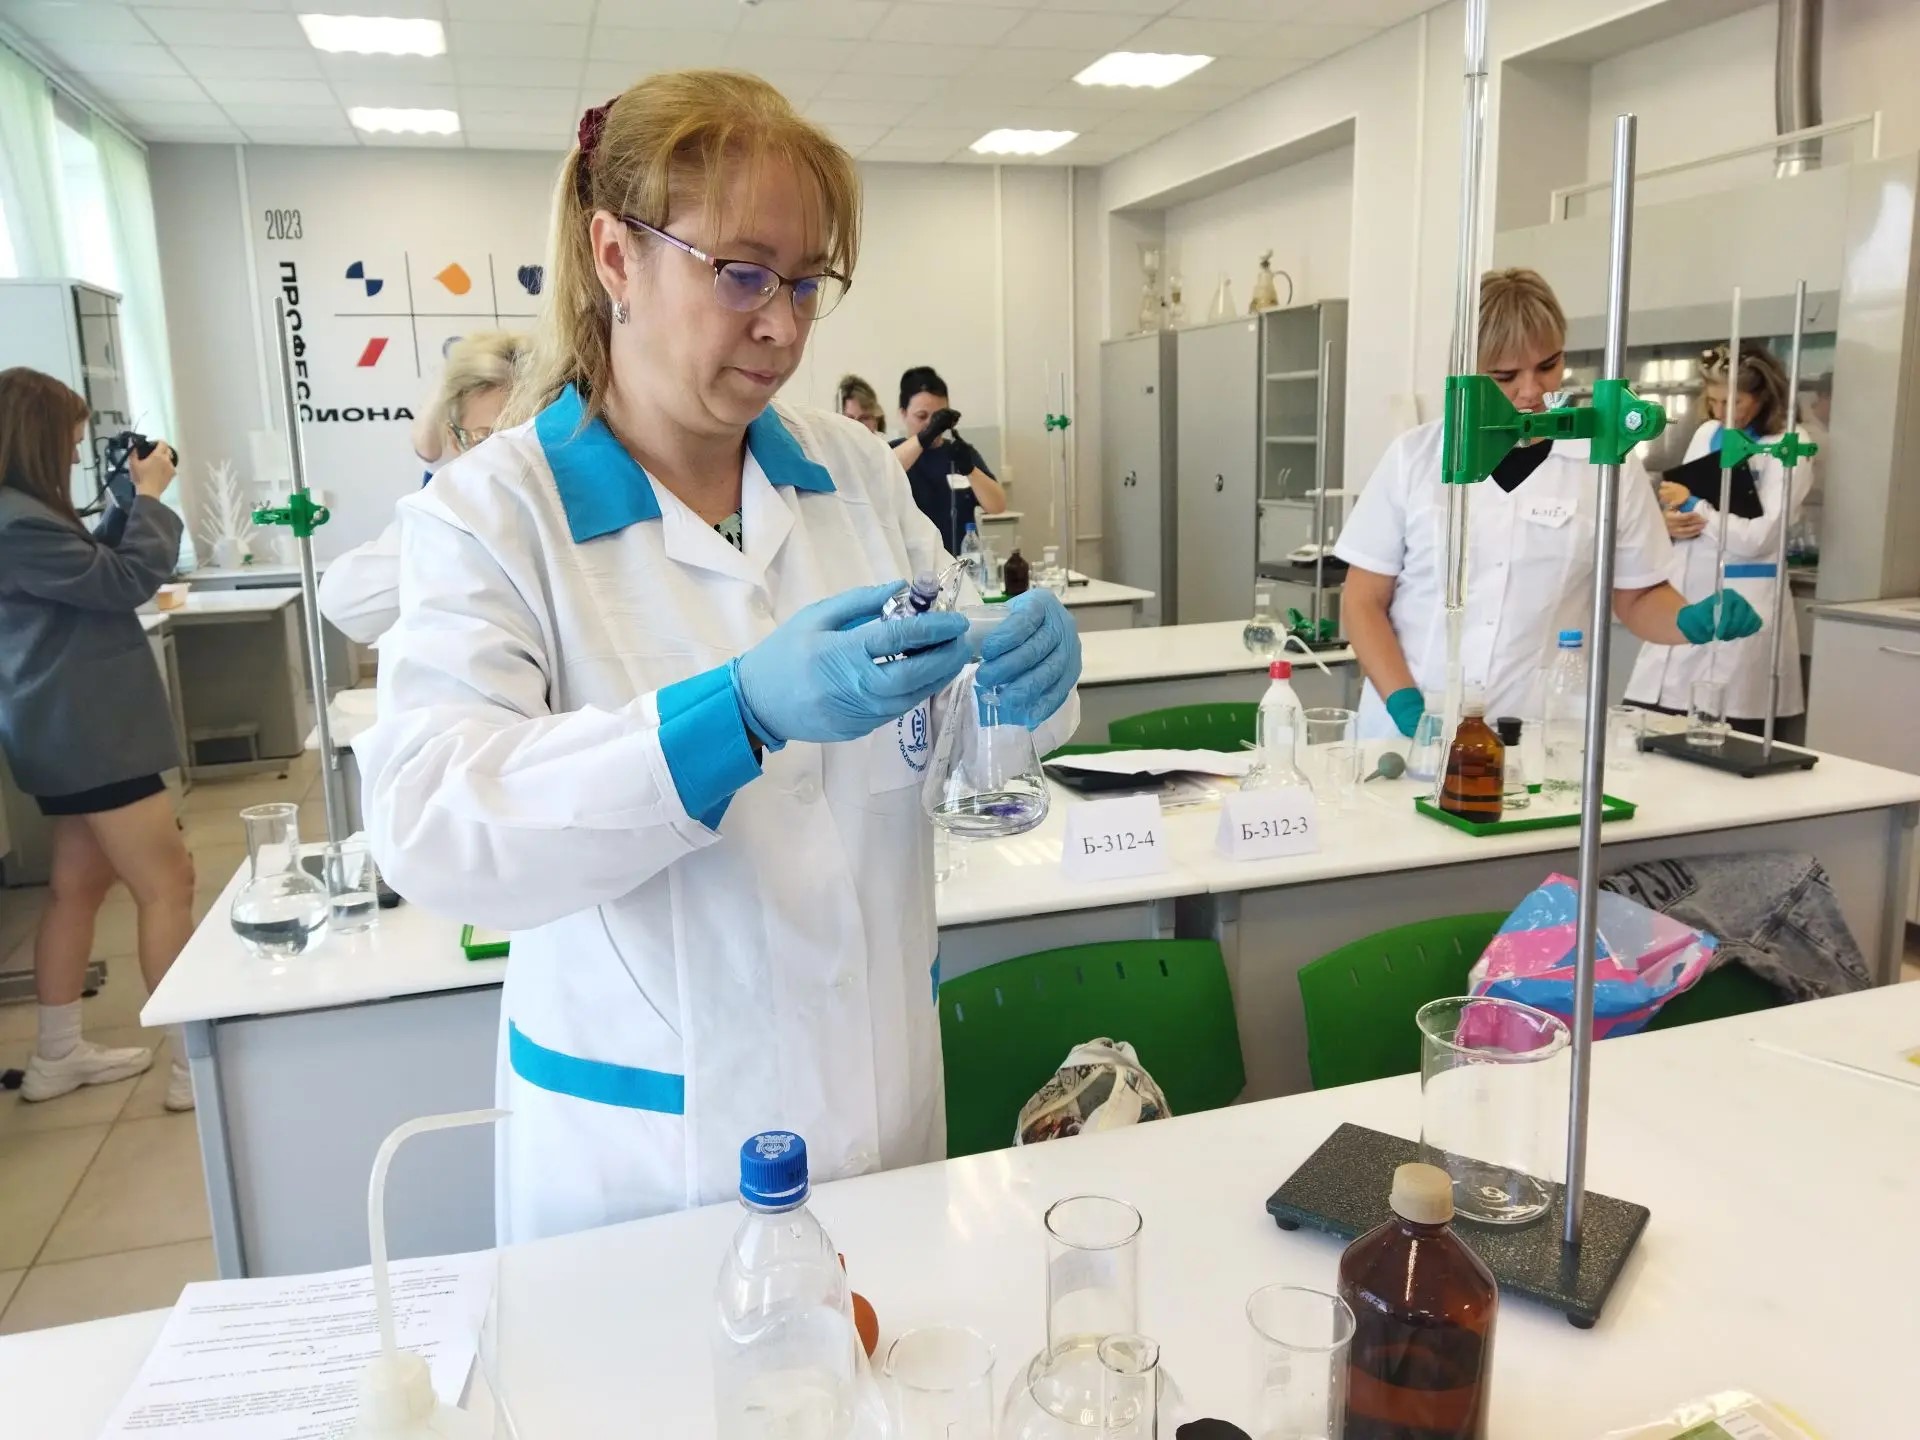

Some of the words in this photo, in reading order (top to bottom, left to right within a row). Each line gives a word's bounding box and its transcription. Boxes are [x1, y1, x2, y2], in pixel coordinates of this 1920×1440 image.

[264, 209, 303, 240] 2023
[1241, 816, 1308, 840] Б-312-3
[1083, 830, 1155, 855] Б-312-4
